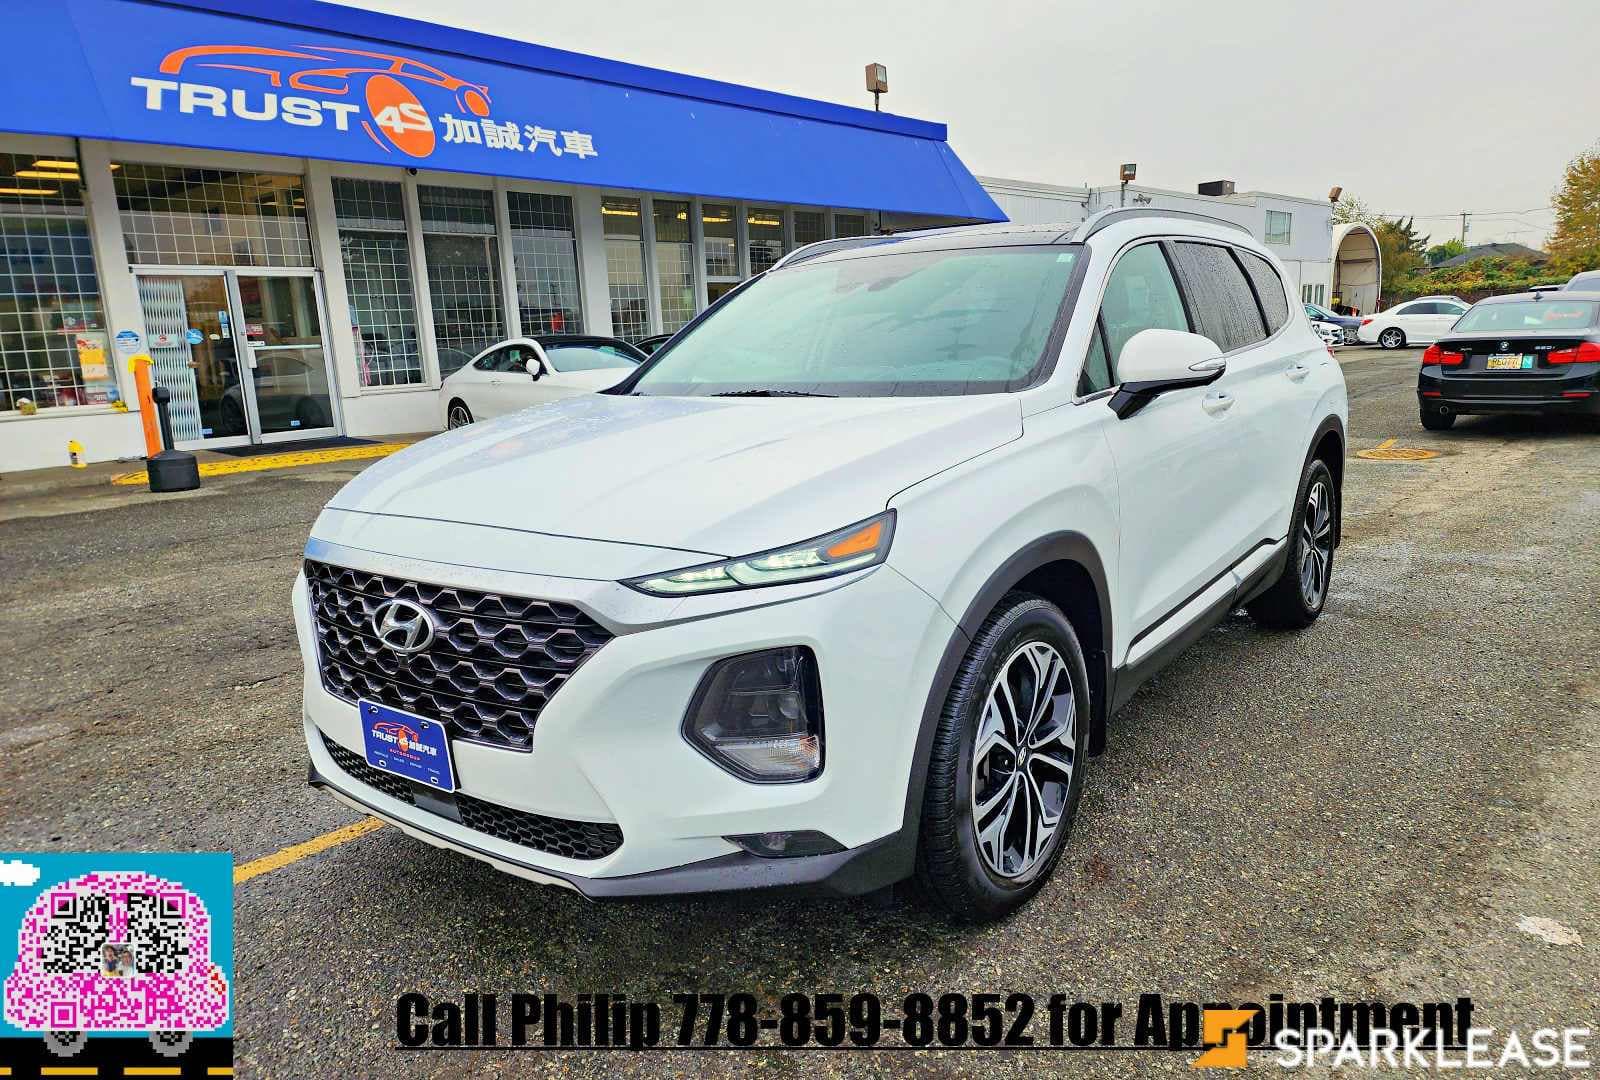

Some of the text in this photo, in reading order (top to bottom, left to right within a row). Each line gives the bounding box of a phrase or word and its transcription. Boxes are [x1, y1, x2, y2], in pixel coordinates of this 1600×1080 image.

[131, 77, 599, 159] TRUST 4S 加誠汽車
[371, 729, 398, 744] TRUST
